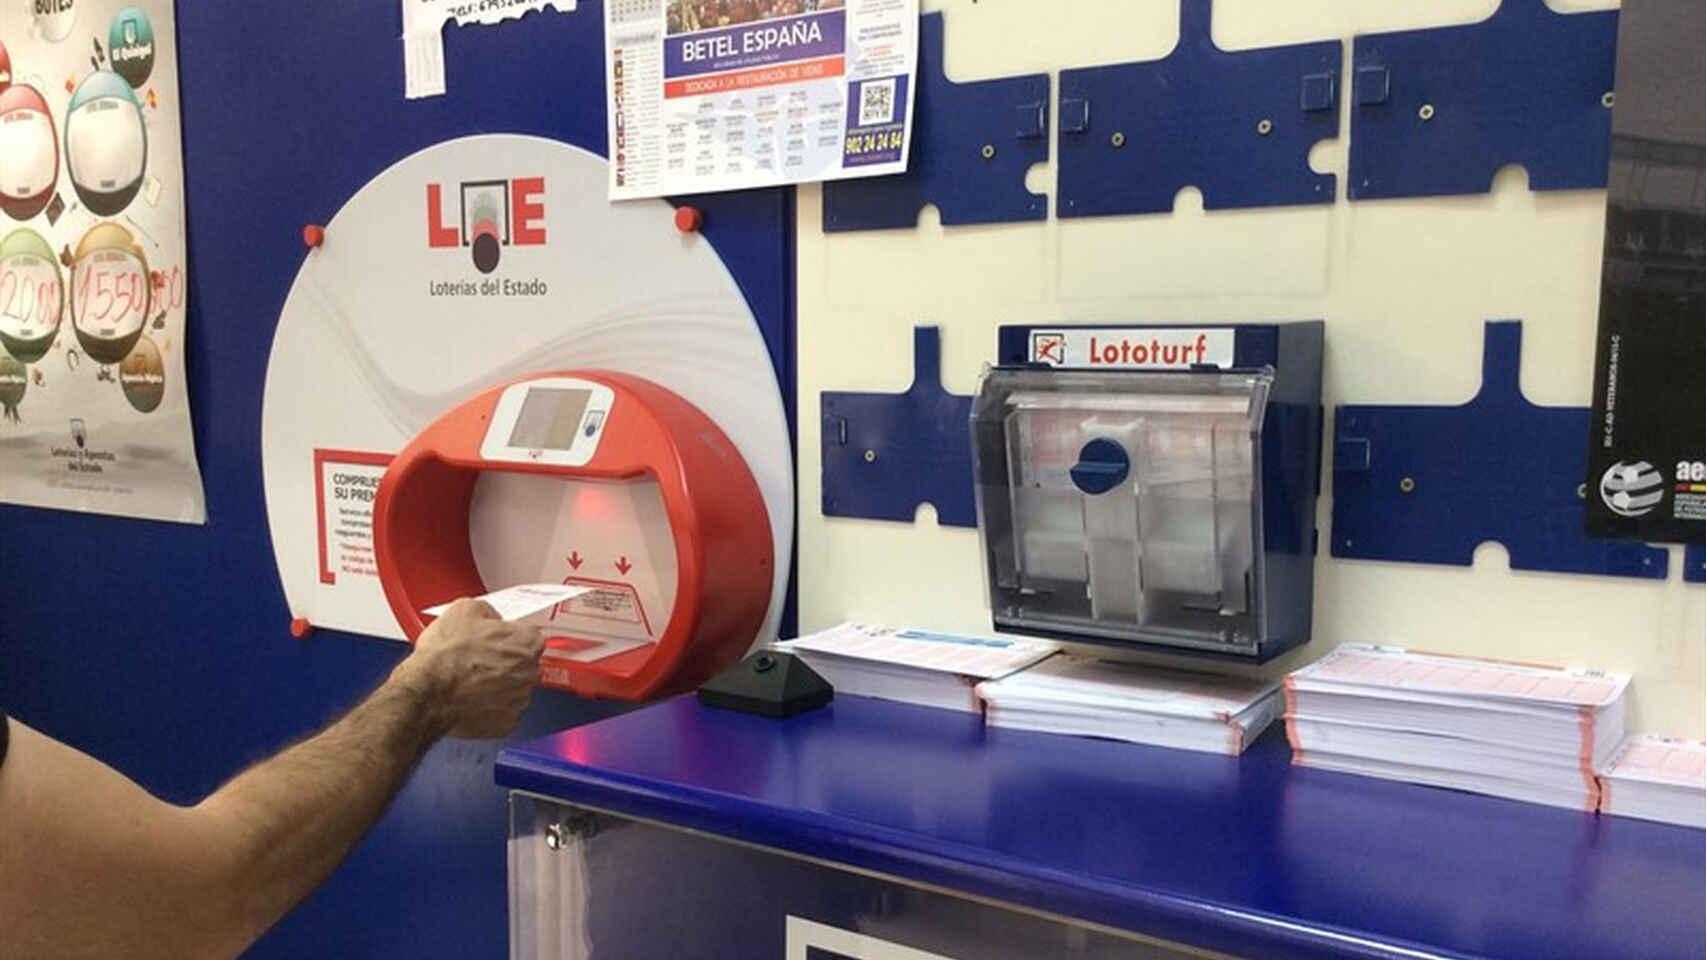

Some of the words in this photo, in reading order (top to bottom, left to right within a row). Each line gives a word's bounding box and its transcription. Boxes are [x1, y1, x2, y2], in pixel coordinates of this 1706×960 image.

[682, 35, 738, 62] BETEL
[743, 21, 822, 53] ESPAÑA
[480, 277, 500, 296] del
[503, 277, 548, 297] Estado
[1089, 333, 1207, 365] Lototurf
